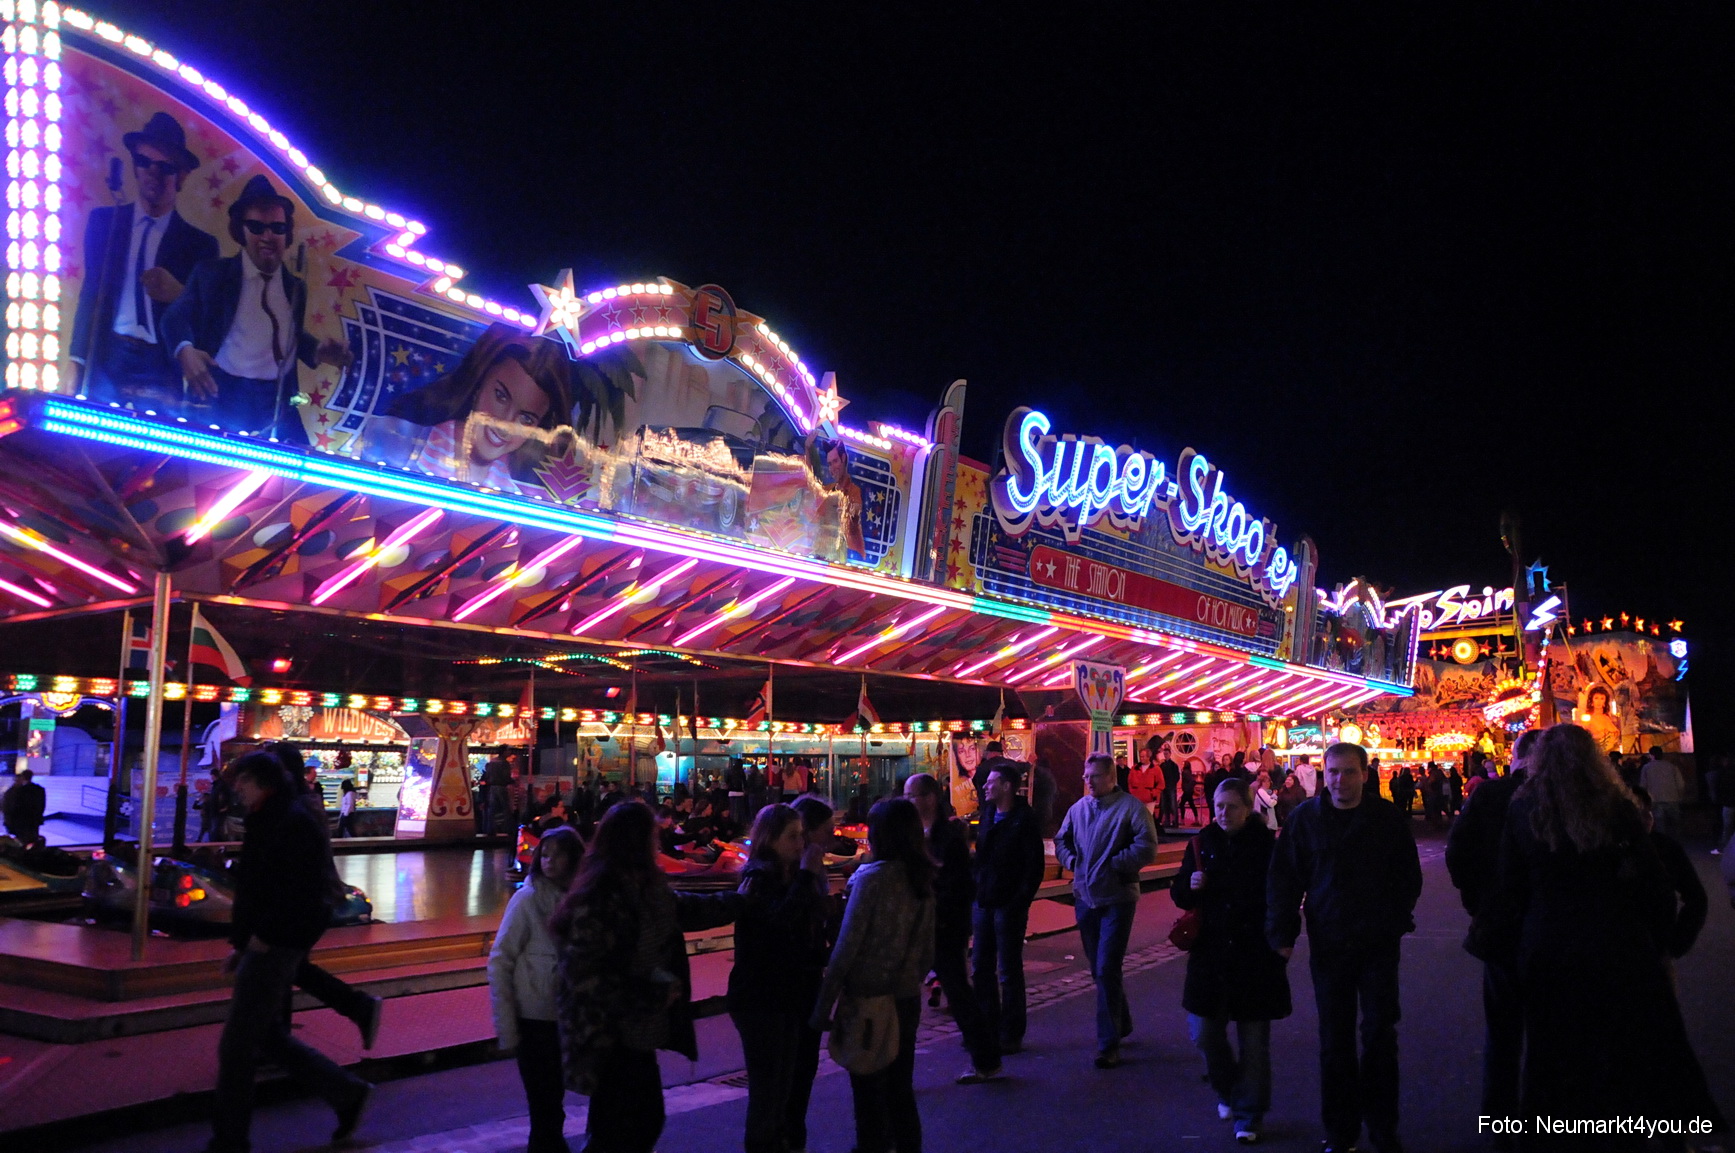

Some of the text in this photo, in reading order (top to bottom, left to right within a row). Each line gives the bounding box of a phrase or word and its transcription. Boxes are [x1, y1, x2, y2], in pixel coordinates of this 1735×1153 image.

[1064, 555, 1081, 589] THE
[1086, 563, 1126, 600] STATION
[1196, 595, 1211, 623] OF
[1211, 600, 1228, 627] HOT
